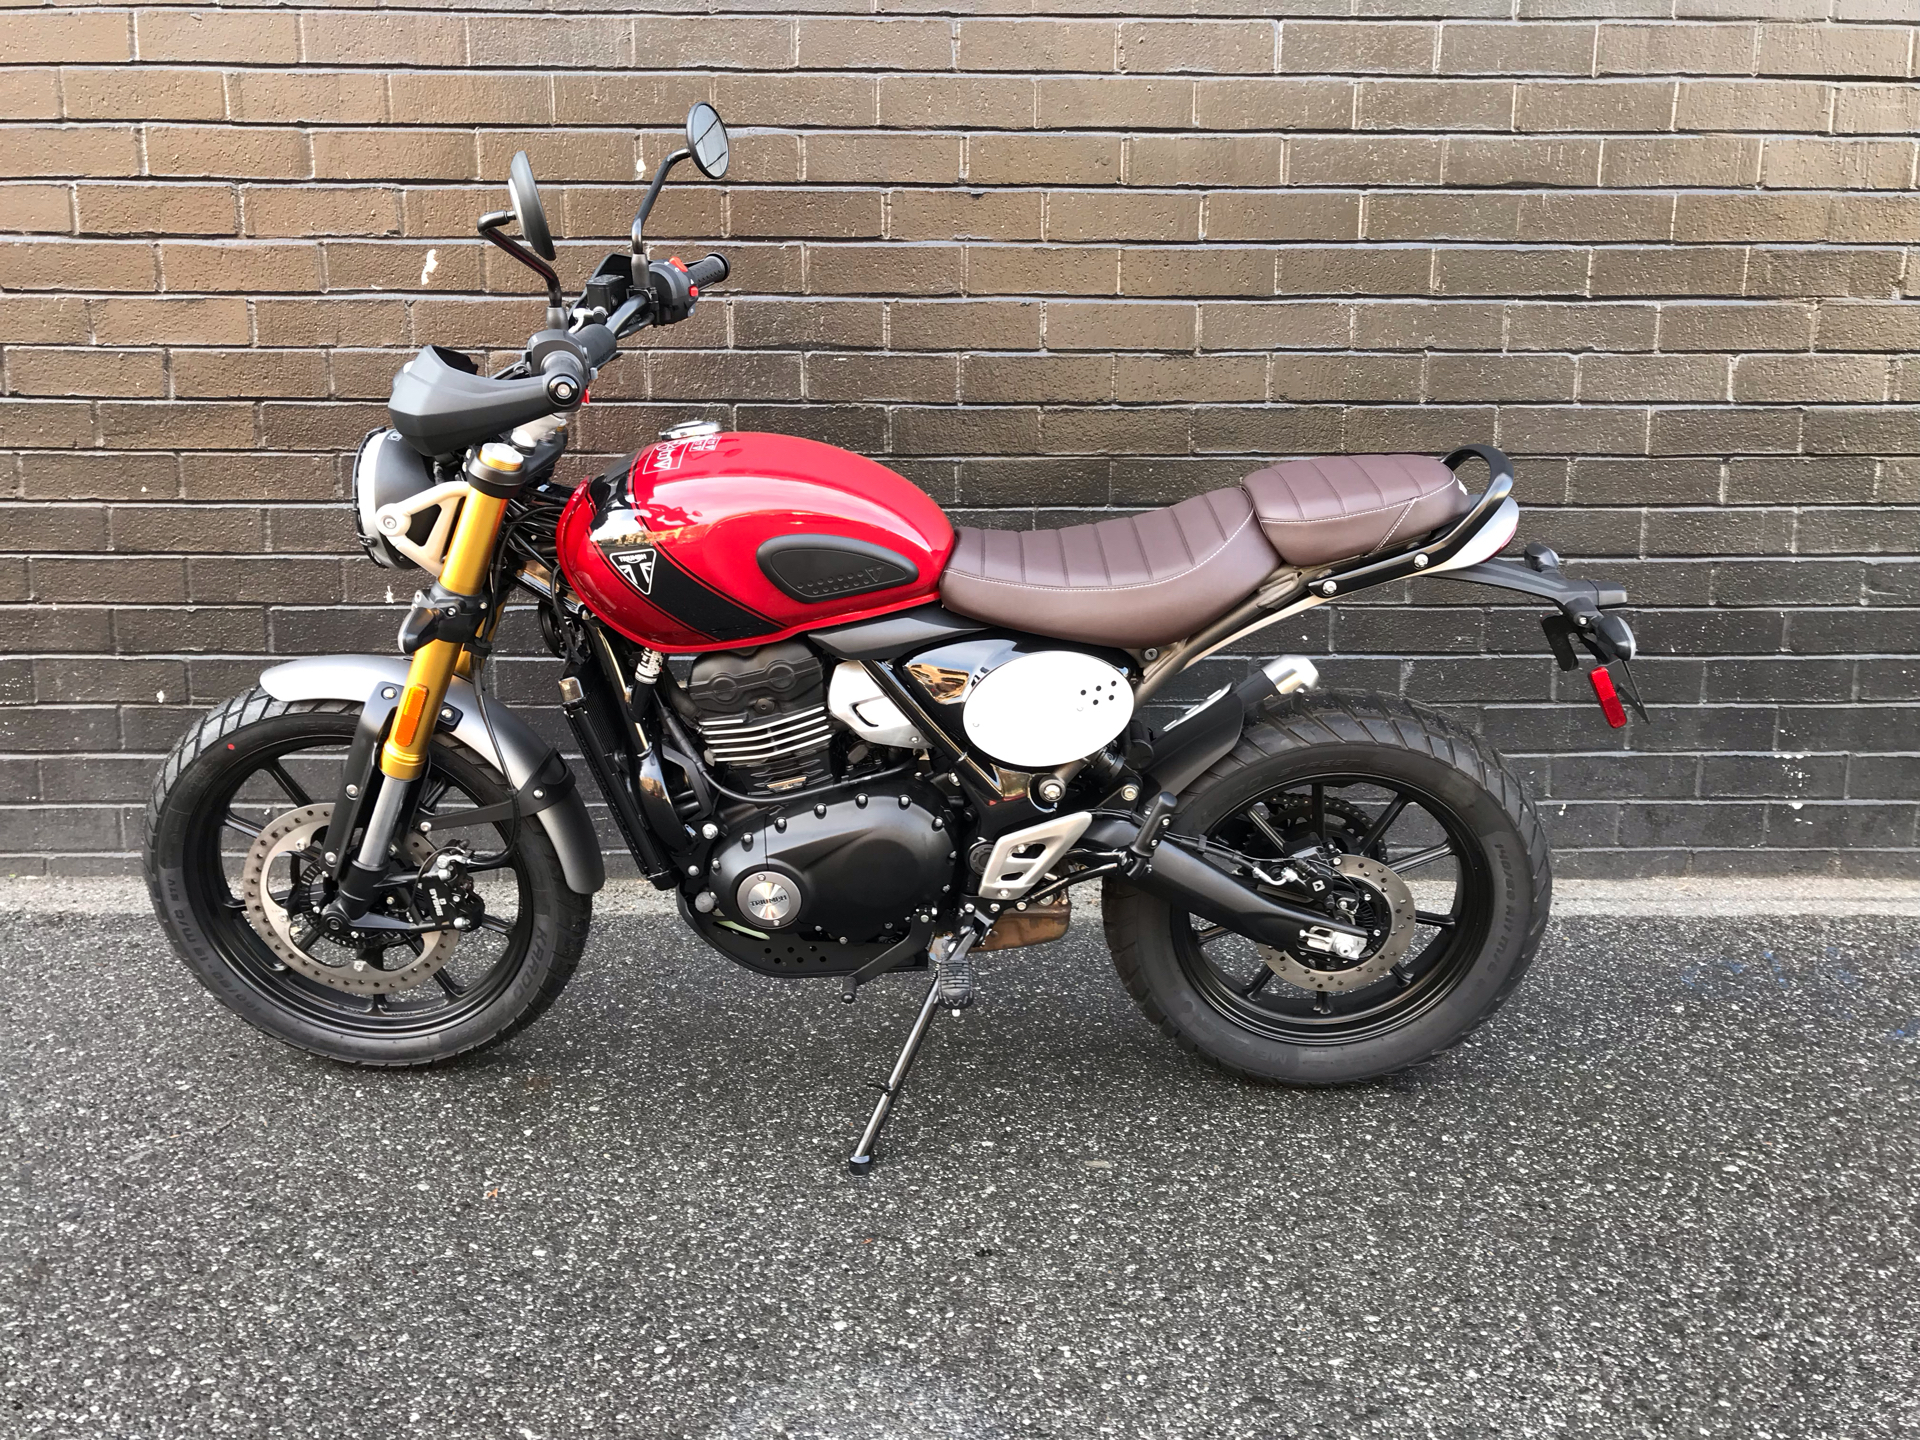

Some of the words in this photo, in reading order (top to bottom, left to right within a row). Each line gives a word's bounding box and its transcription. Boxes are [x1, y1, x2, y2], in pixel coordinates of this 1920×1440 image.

[618, 553, 648, 564] TRIUMPH
[1278, 758, 1361, 778] STREET
[750, 895, 788, 907] TRIUMPH
[513, 926, 548, 999] KAROO
